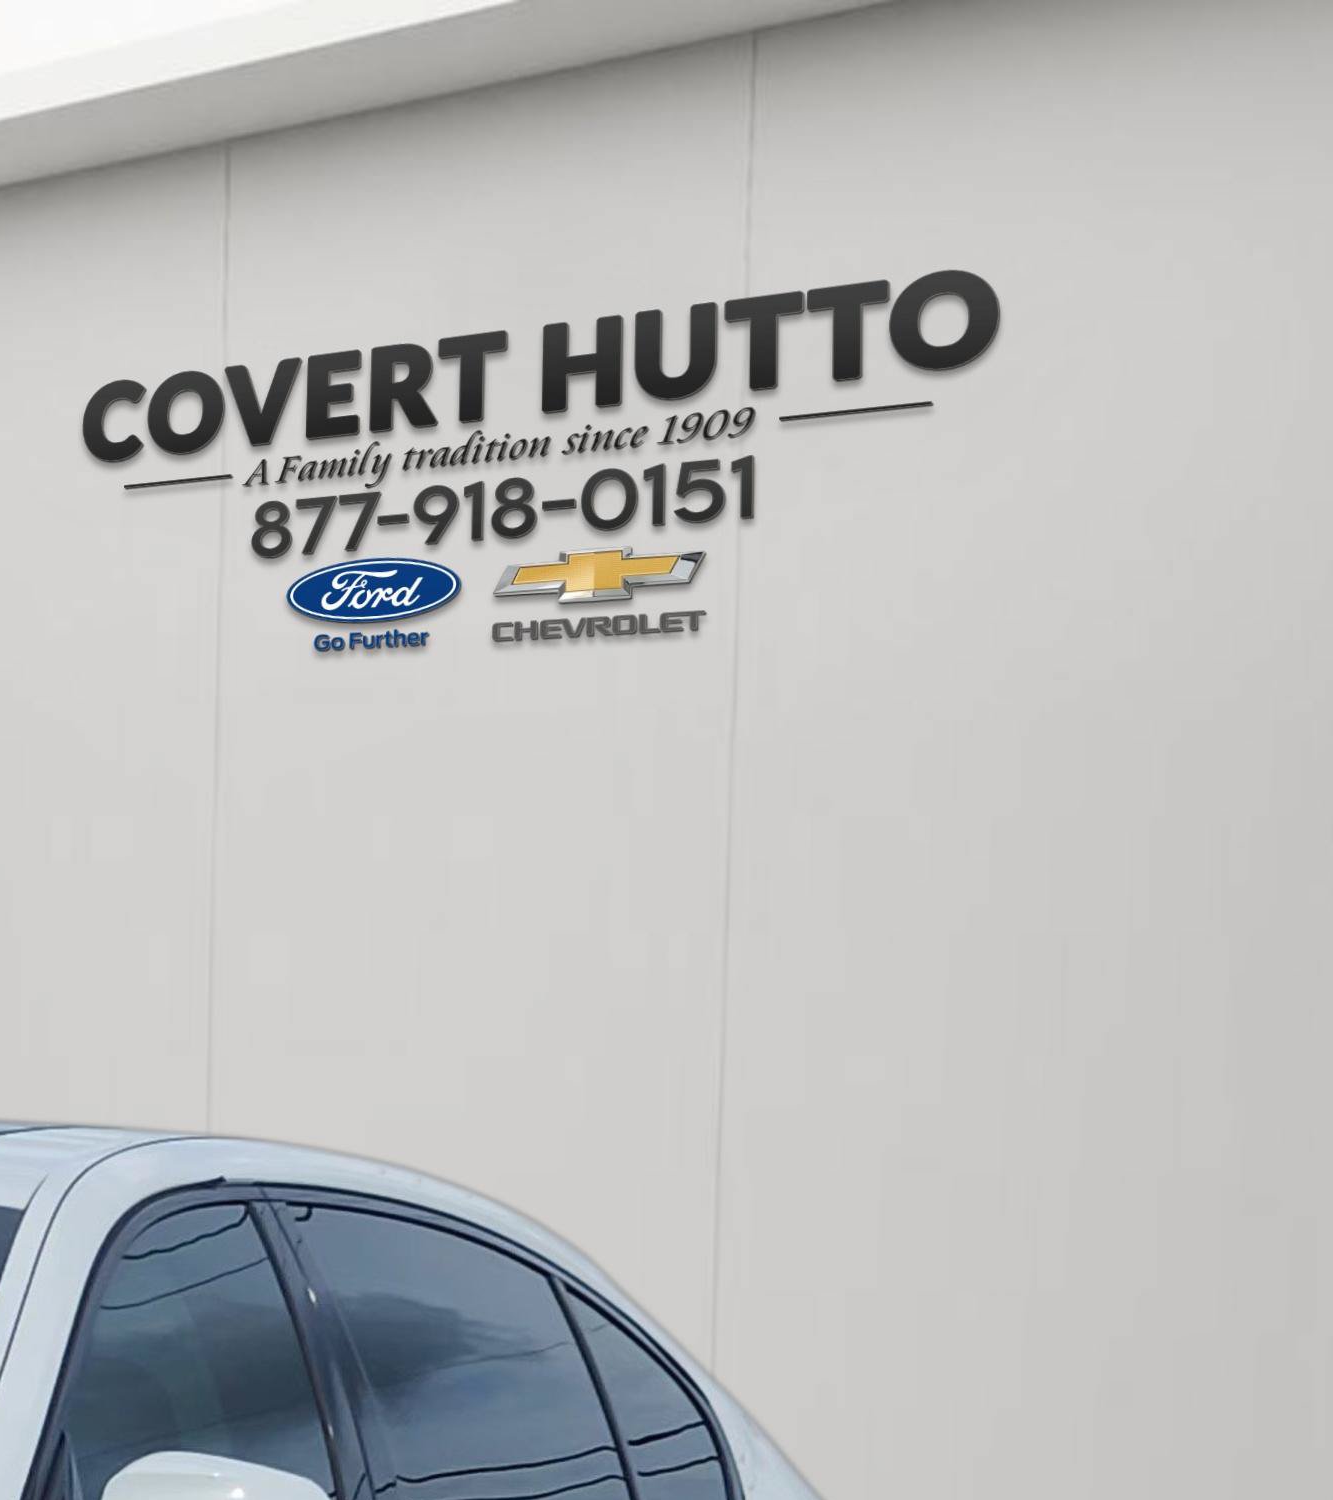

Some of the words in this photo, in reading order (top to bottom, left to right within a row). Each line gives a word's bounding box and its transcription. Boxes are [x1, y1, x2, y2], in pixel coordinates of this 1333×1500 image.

[81, 329, 509, 463] COVERT
[541, 269, 1001, 413] HUTTO
[243, 459, 269, 487] A
[276, 441, 392, 488] Family
[402, 431, 550, 472] tradition
[561, 424, 649, 455] since
[656, 407, 756, 446] 1909
[251, 455, 755, 559] 877-918-0151
[321, 569, 421, 611] Ford
[313, 633, 344, 652] Go
[349, 629, 429, 650] Further
[491, 609, 707, 642] CHEVROLET
